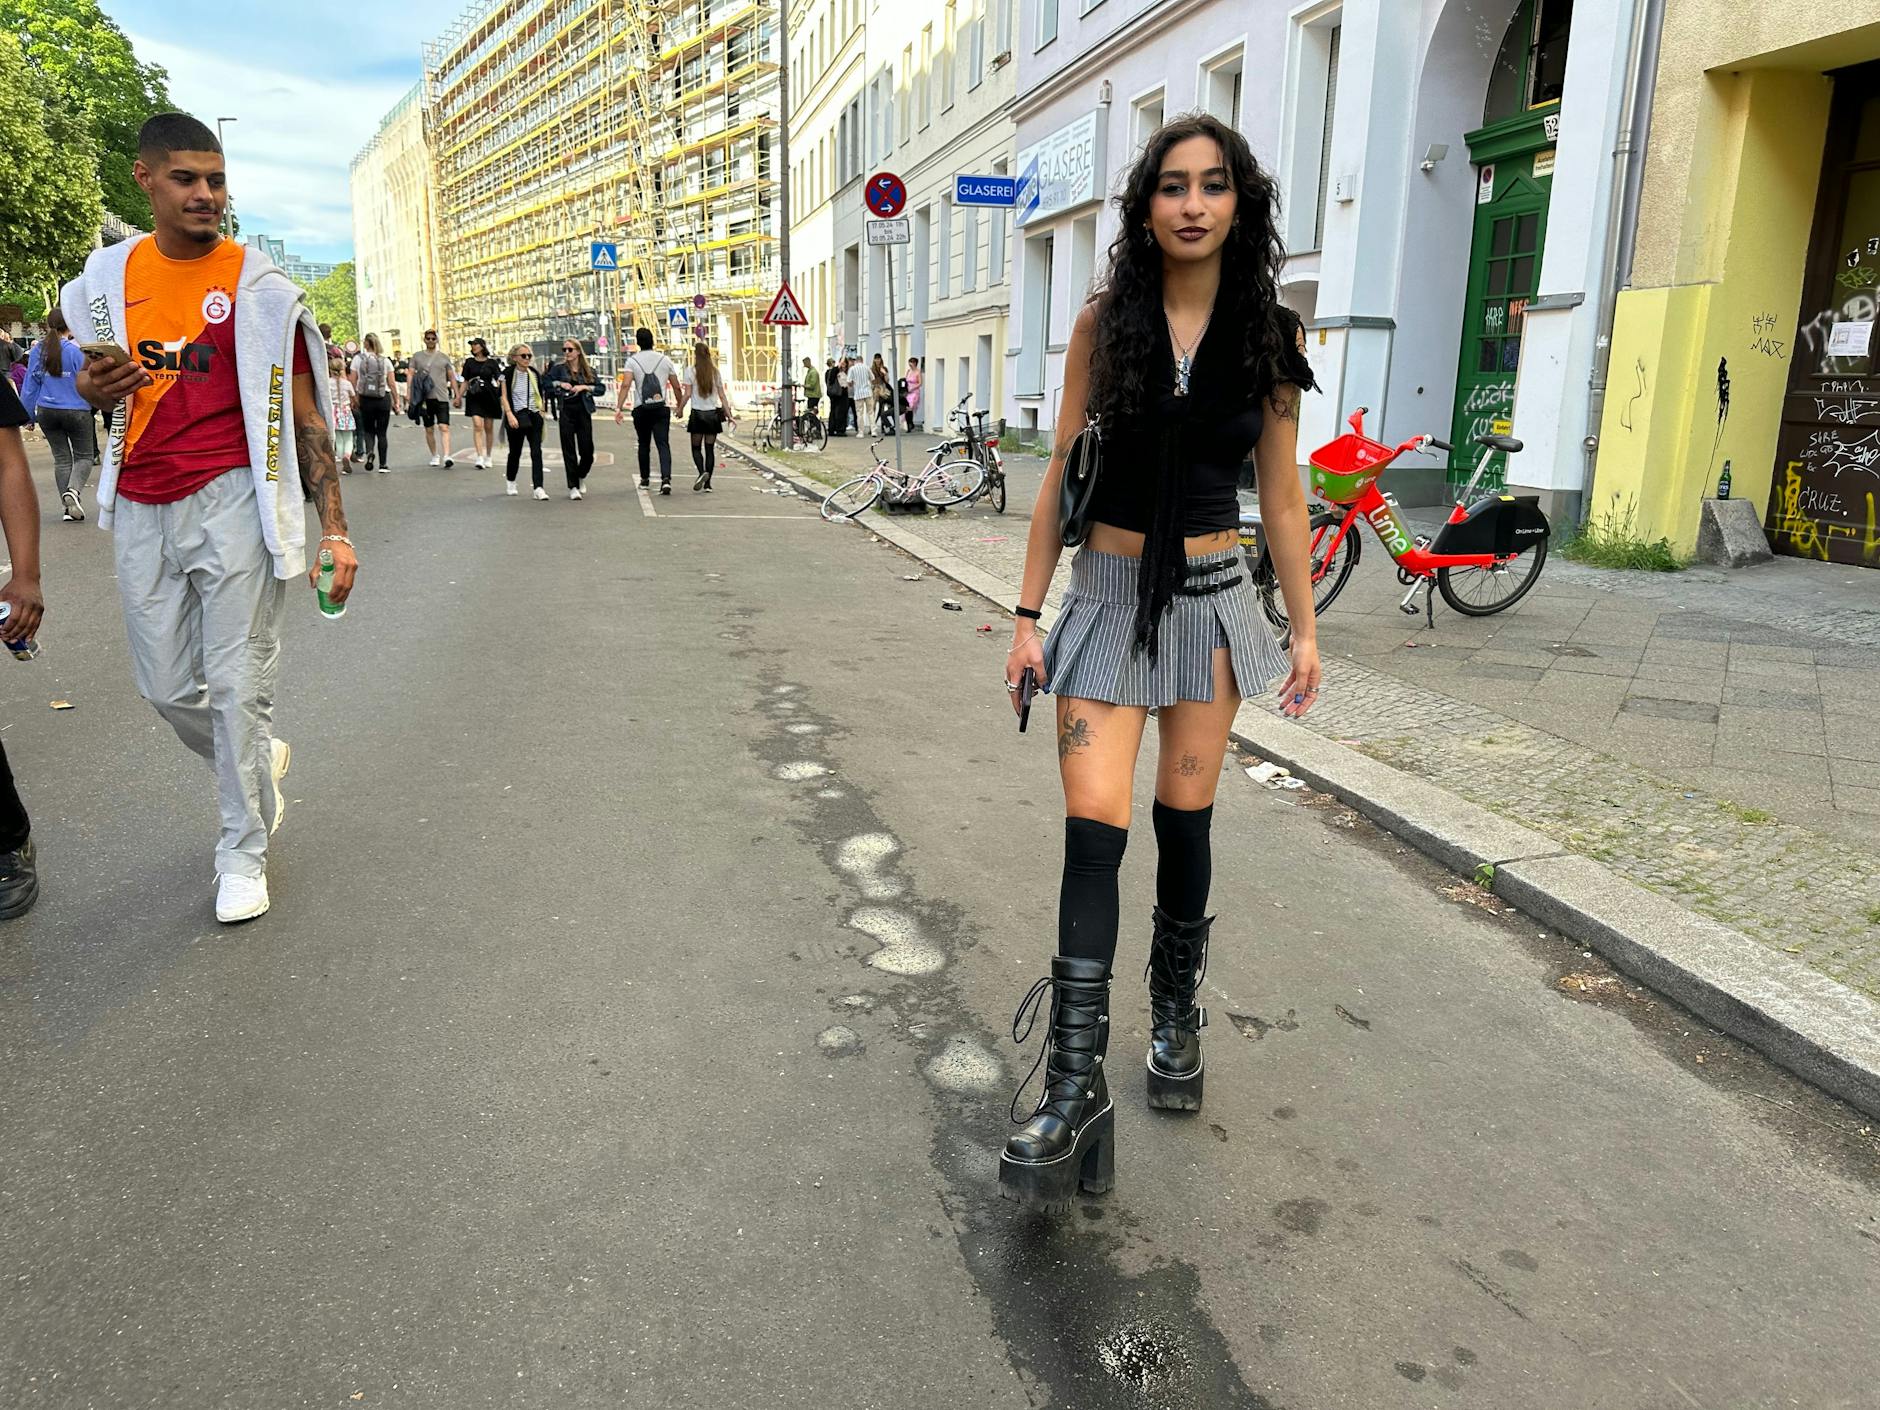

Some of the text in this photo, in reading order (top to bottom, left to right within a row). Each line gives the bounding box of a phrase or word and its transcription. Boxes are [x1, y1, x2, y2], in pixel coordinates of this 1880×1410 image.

[1546, 118, 1559, 135] 52
[1040, 136, 1095, 190] GLASEREI
[959, 184, 1014, 198] GLASEREI
[1369, 504, 1408, 553] Lime
